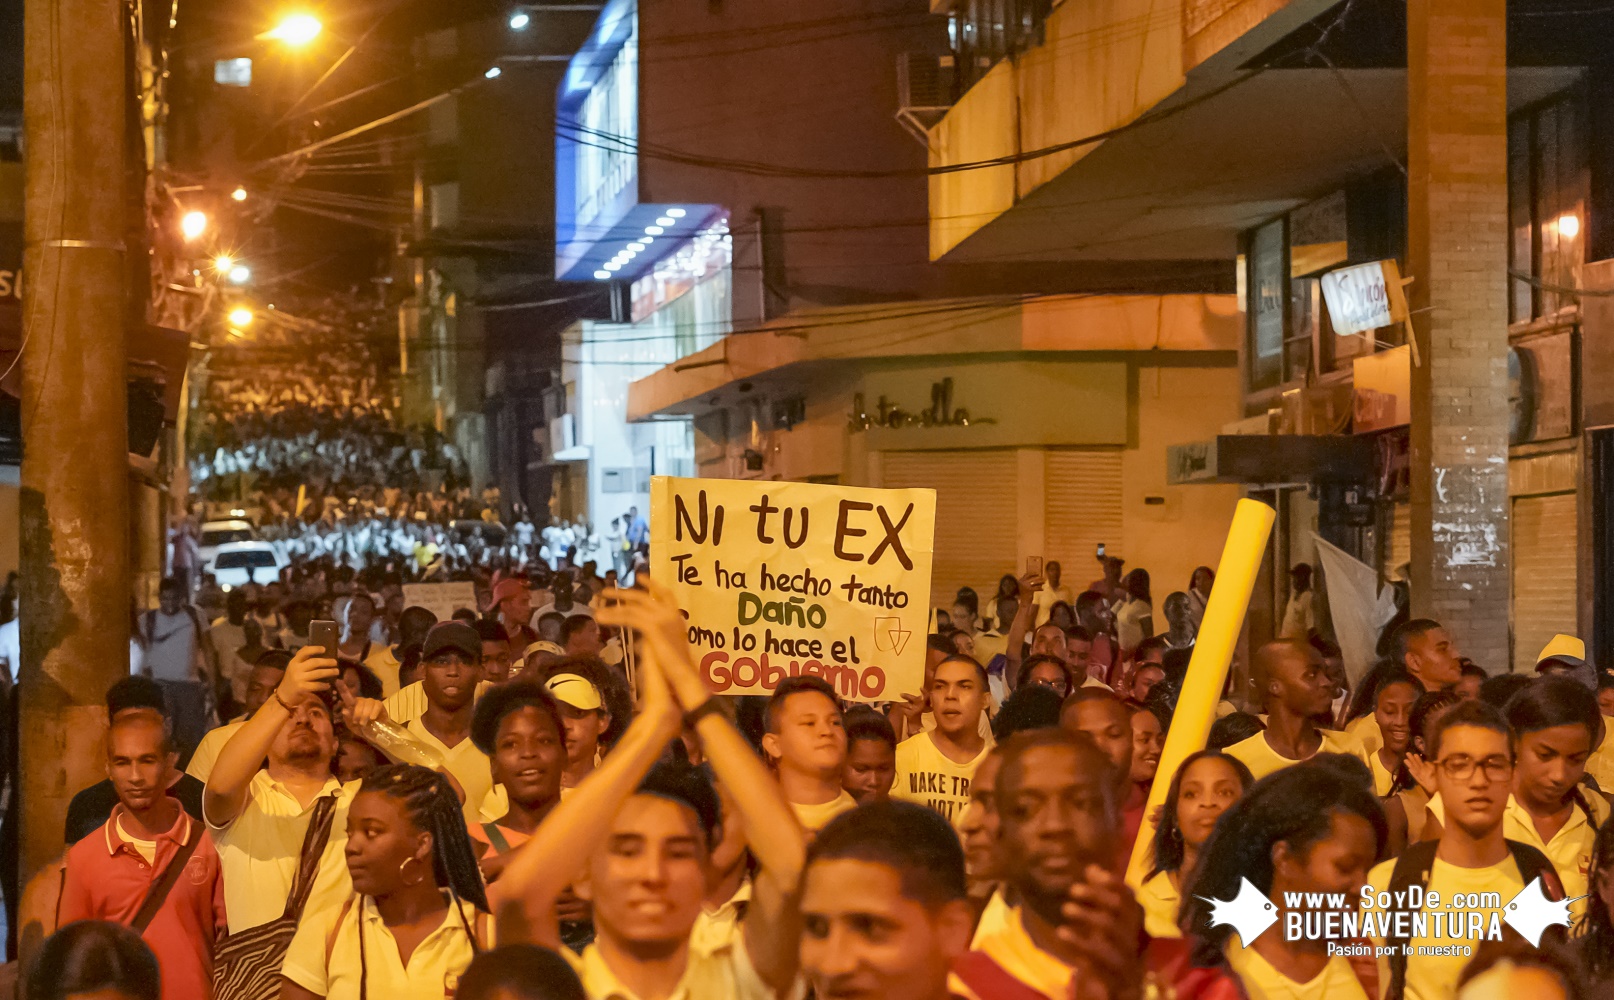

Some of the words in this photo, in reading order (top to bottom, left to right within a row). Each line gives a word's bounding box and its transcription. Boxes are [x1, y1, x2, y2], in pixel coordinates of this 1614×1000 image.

[834, 499, 915, 571] EX
[670, 553, 703, 586] Te
[714, 560, 748, 589] ha
[760, 563, 832, 596] hecho
[840, 575, 909, 609] tanto
[678, 608, 726, 649] omo
[733, 626, 757, 651] lo
[765, 628, 823, 660] hace
[830, 636, 861, 664] el
[737, 591, 827, 629] Daño
[909, 771, 946, 794] MAKE
[951, 775, 970, 797] TR
